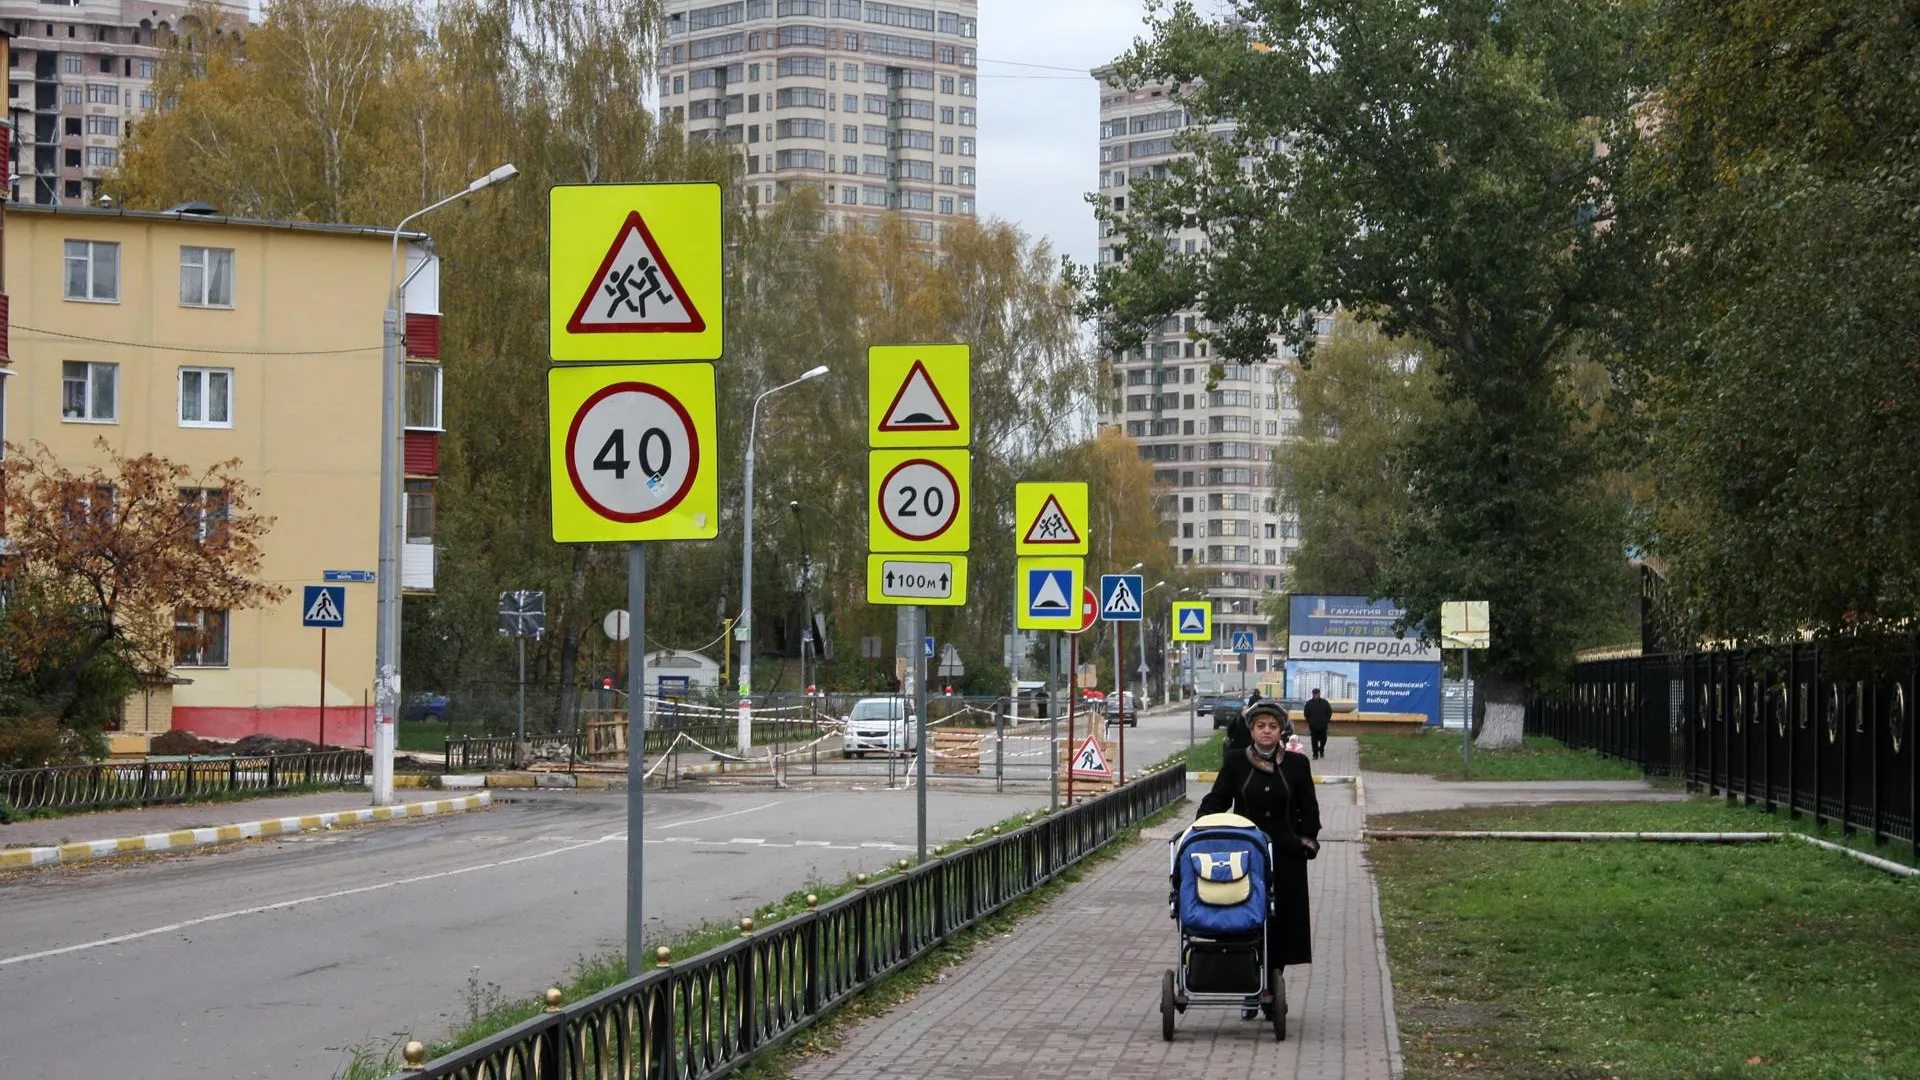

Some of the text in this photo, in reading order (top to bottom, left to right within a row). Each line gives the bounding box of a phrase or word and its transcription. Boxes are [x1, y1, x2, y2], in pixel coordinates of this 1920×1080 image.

[593, 427, 672, 480] 40
[898, 486, 944, 517] 20
[1300, 640, 1428, 657] ОФИС ПРОДАЖ
[1366, 680, 1380, 688] ЖК
[1366, 697, 1389, 705] выбор
